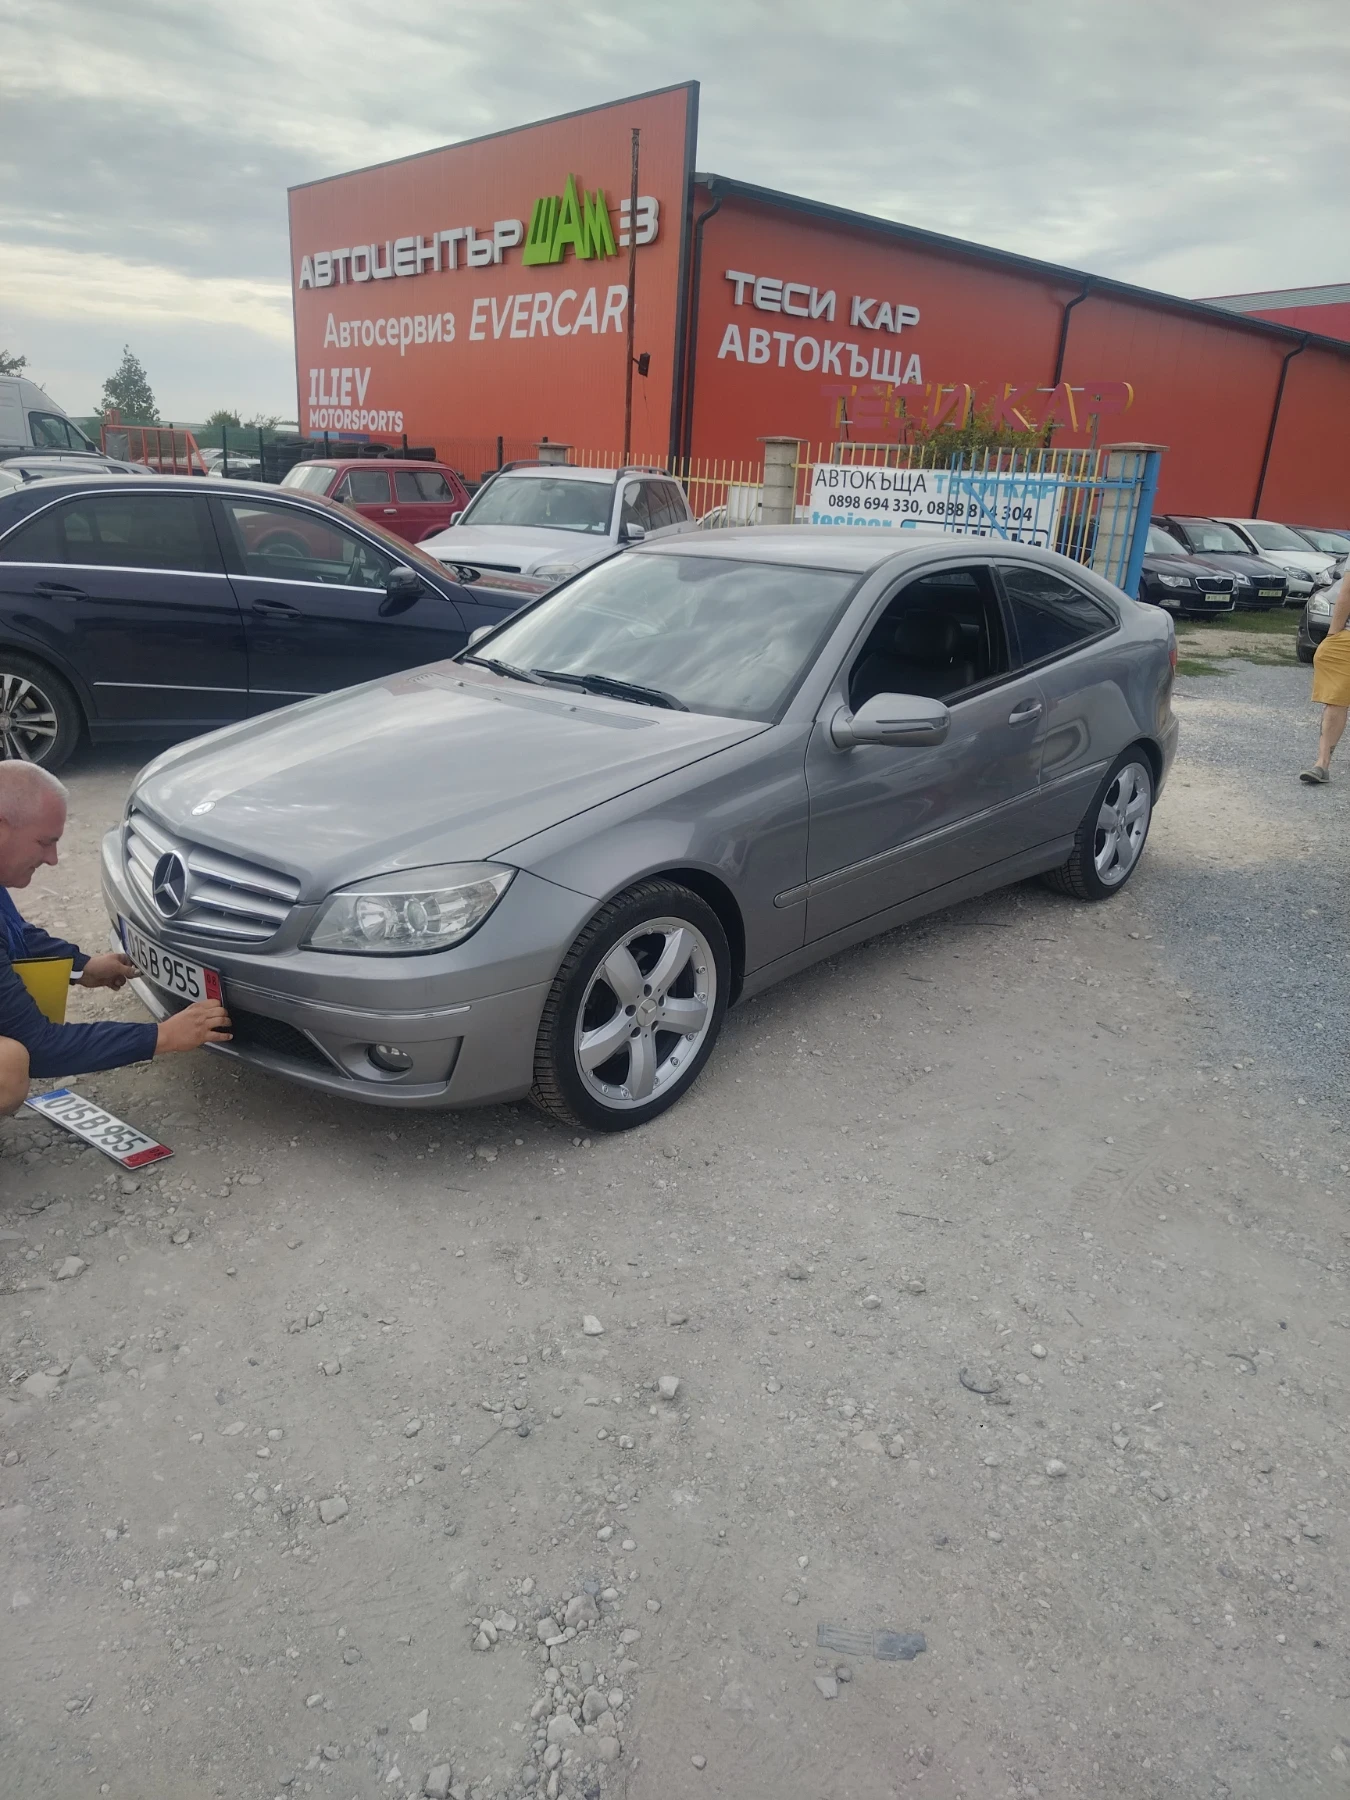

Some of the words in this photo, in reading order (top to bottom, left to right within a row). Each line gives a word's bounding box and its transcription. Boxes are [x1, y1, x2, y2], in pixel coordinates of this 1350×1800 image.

[299, 218, 523, 289] АВТОЦЕНТЪР
[521, 173, 618, 266] ШАМ
[323, 311, 456, 356] Автосервиз
[469, 284, 629, 341] EVERCAR
[725, 269, 836, 322] ТЕСИ
[850, 295, 921, 334] КАР
[717, 323, 923, 386] АВТОКЪЩА
[308, 366, 372, 406] ILIEV
[309, 408, 404, 433] MOTORSPORTS
[814, 468, 927, 496] АВТОКЪЩА
[1003, 477, 1056, 500] КАР
[828, 494, 861, 509] 0898
[864, 496, 889, 511] 694
[892, 498, 923, 516] 330,
[926, 500, 965, 517] 0888
[1001, 505, 1033, 521] 304
[162, 955, 200, 998] 955
[89, 1125, 148, 1153] 955
